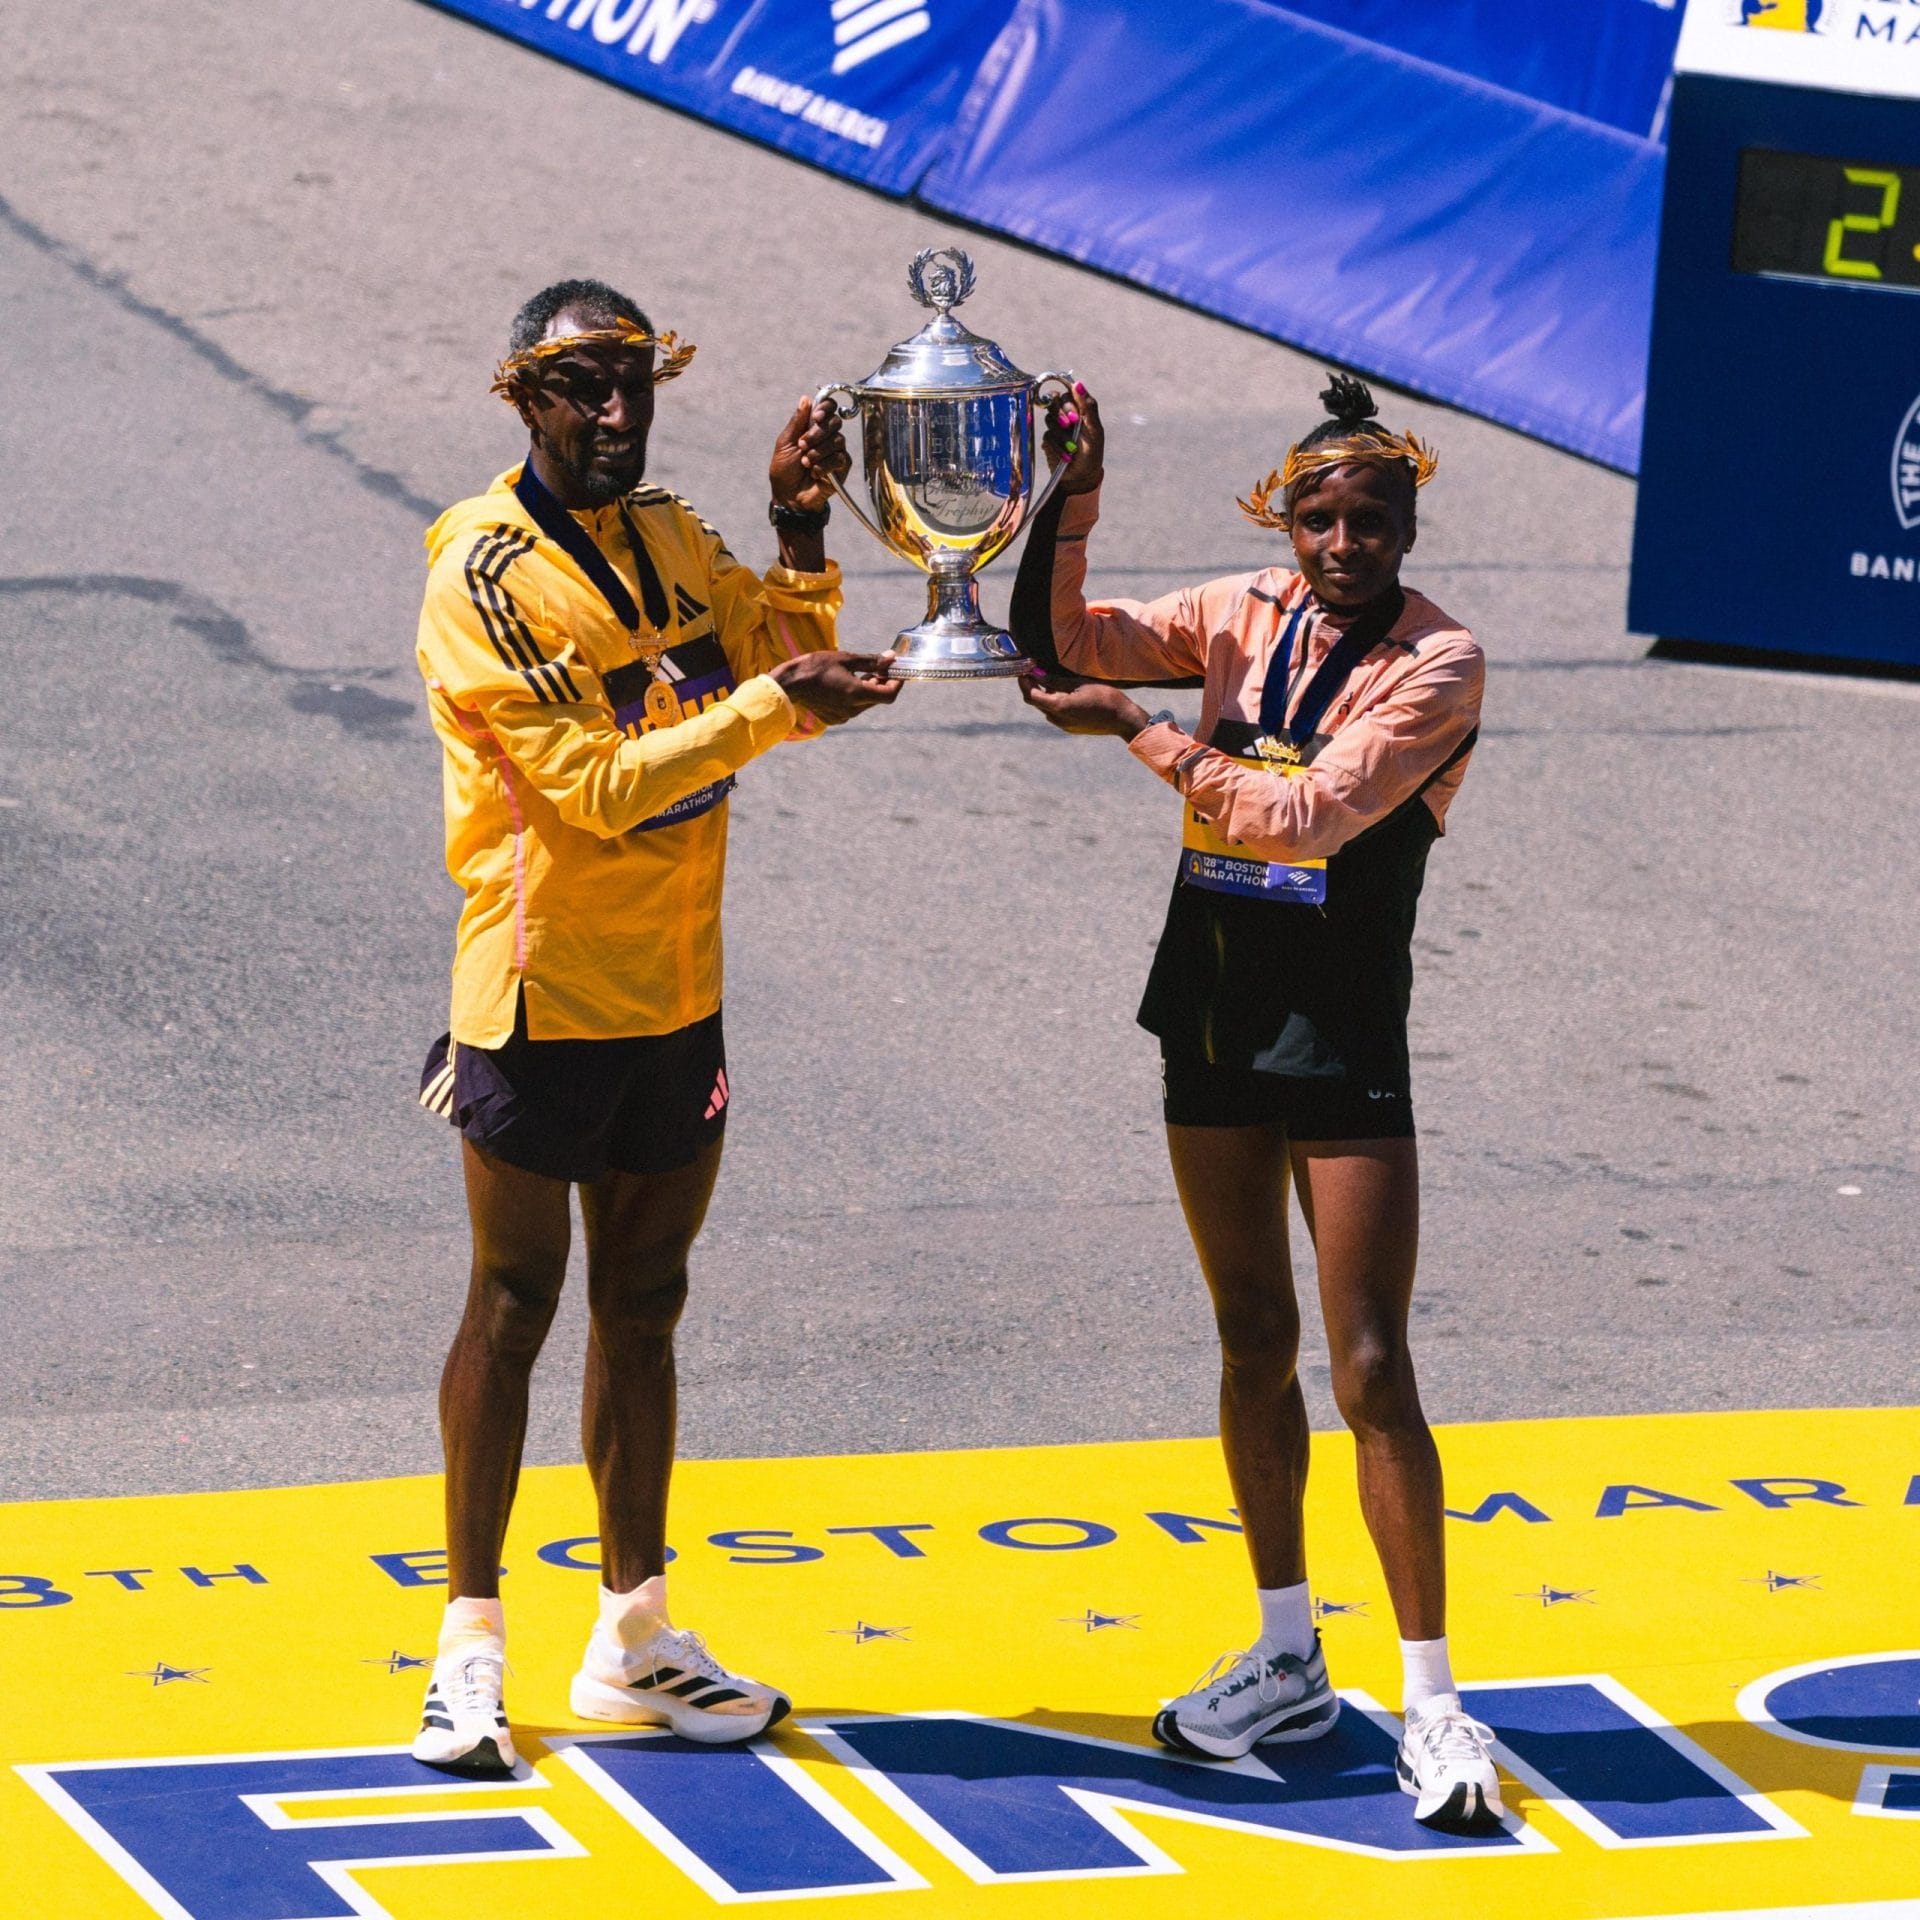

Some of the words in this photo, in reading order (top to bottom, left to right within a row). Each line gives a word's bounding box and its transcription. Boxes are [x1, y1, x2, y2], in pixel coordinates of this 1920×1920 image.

[936, 498, 994, 523] Trophy
[1850, 552, 1920, 582] BAN
[1203, 868, 1270, 888] MARATHON
[1225, 860, 1270, 876] BOSTON
[1443, 1474, 1920, 1524] MAR
